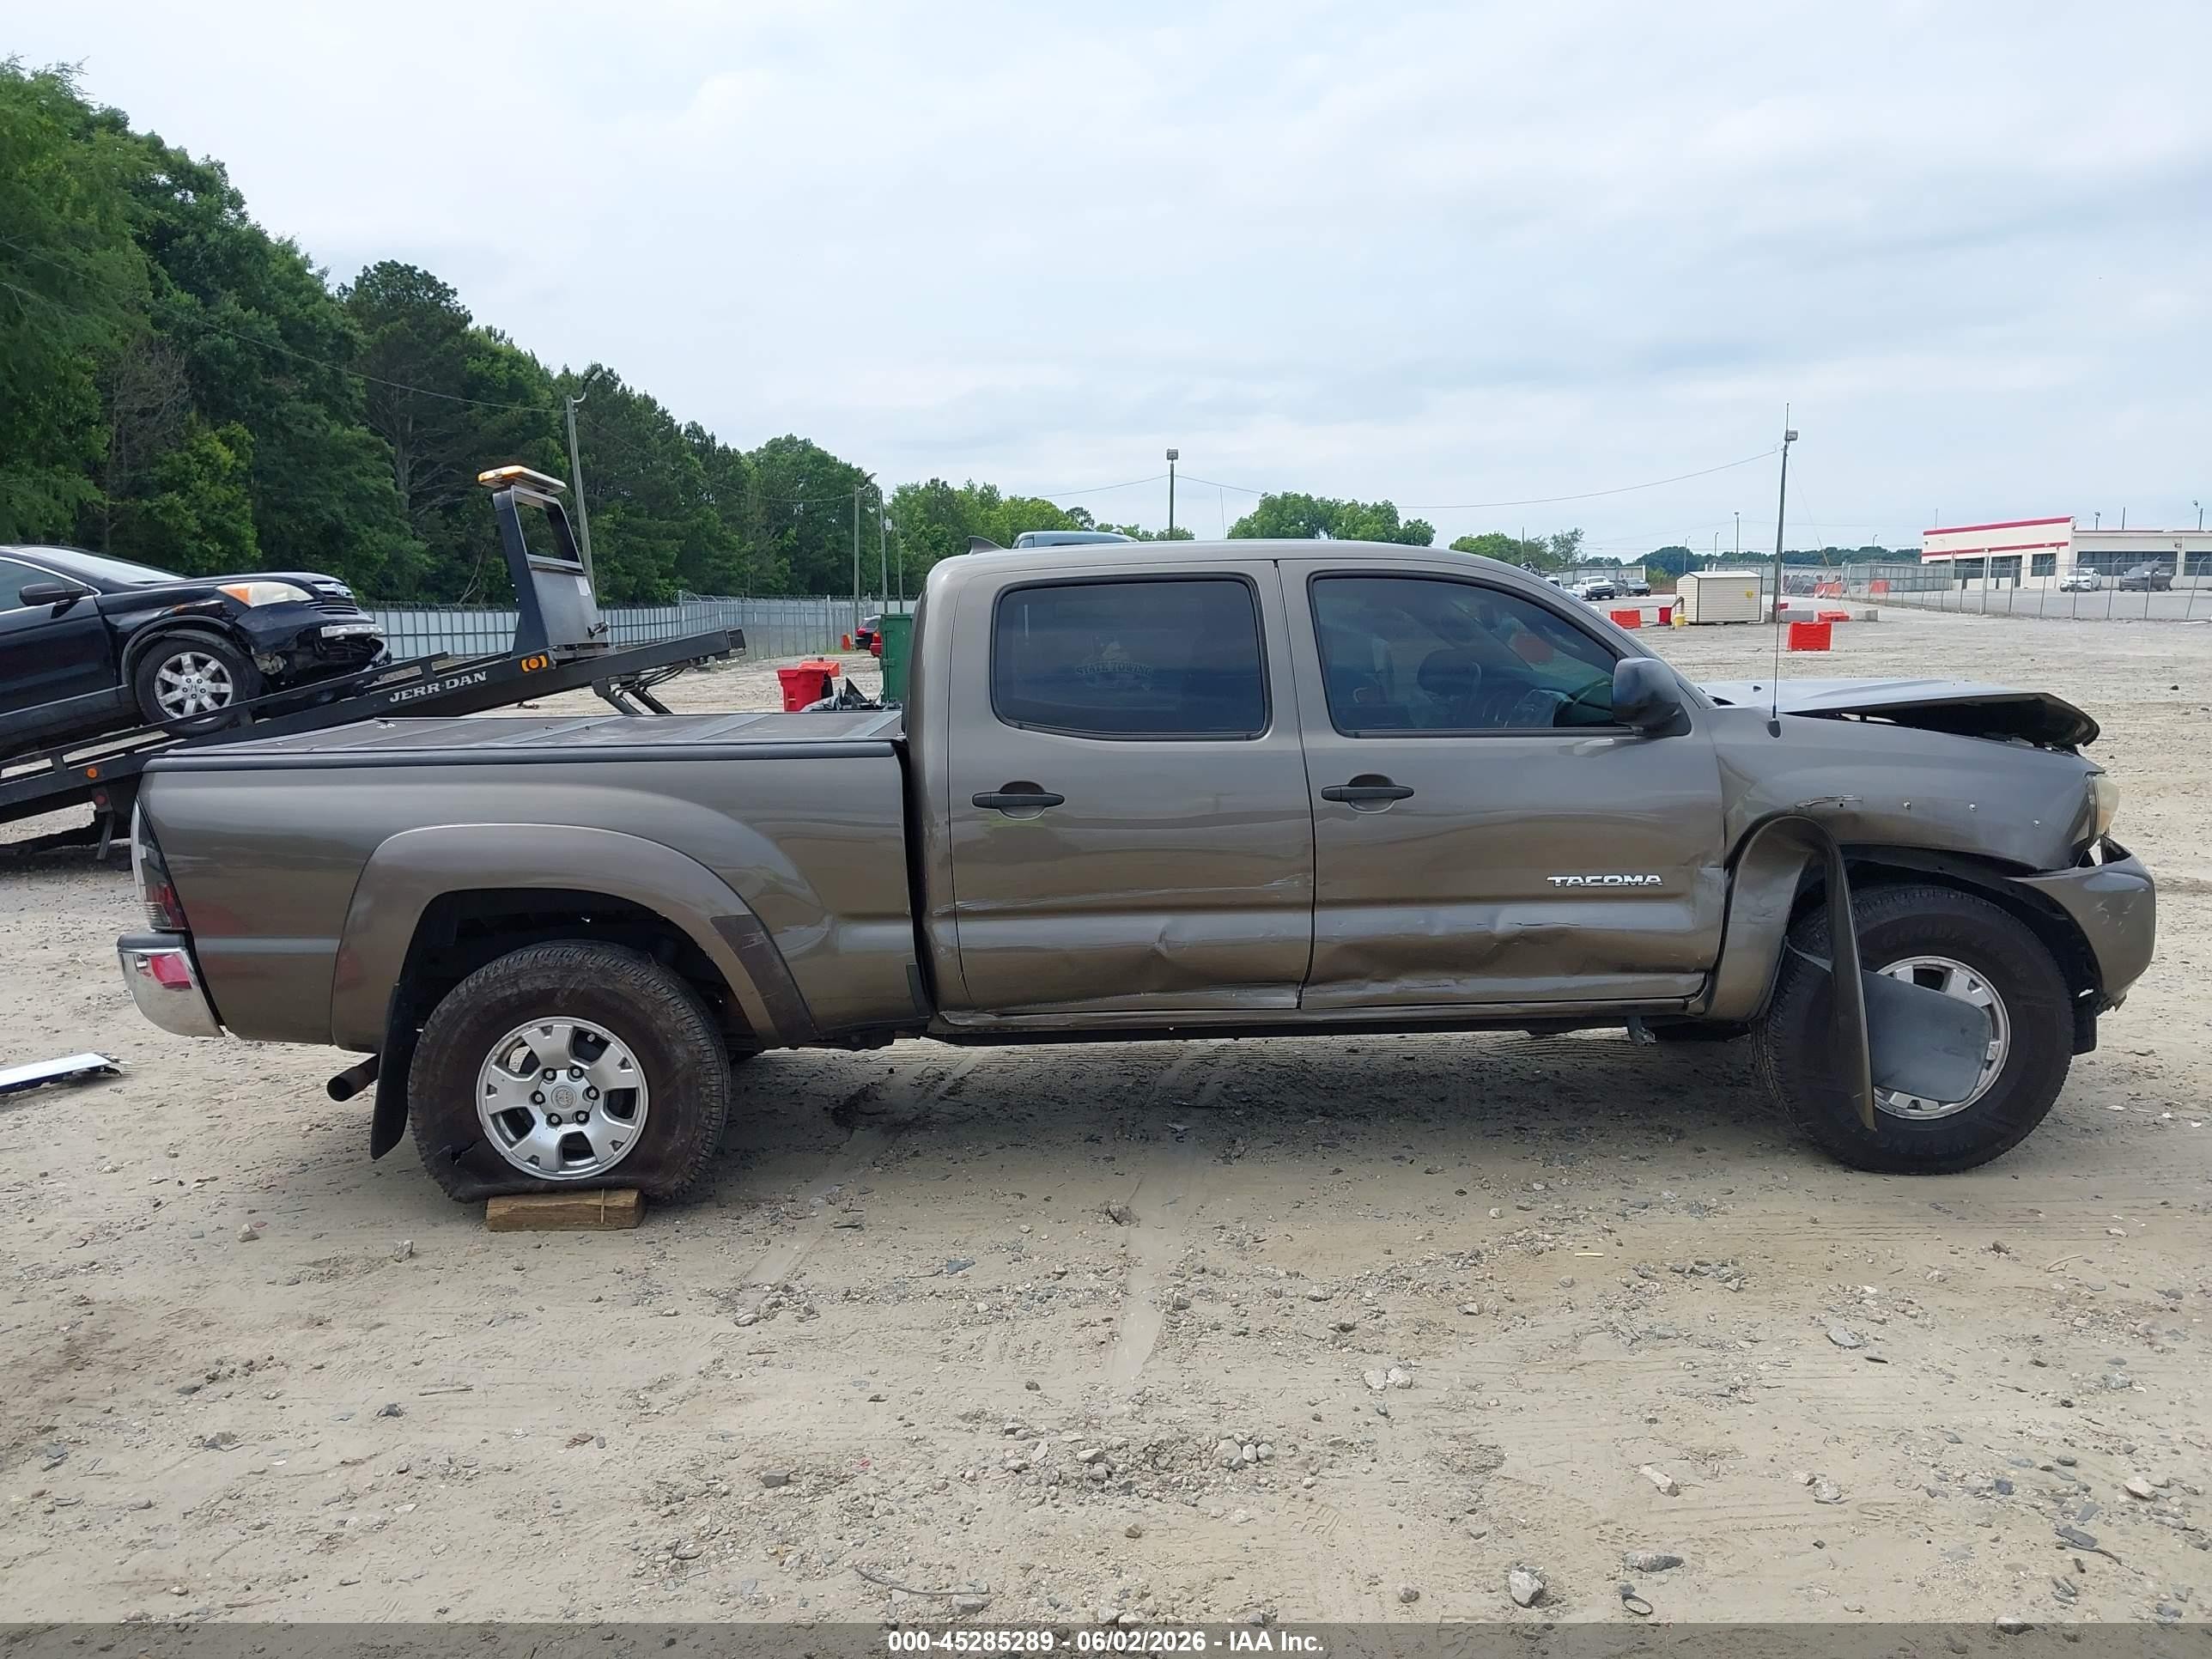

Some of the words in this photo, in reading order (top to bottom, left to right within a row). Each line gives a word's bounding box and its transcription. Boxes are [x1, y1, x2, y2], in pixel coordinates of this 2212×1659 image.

[1076, 660, 1109, 676] STATE
[1110, 660, 1152, 676] TOWING
[1547, 875, 1662, 886] TACOMA
